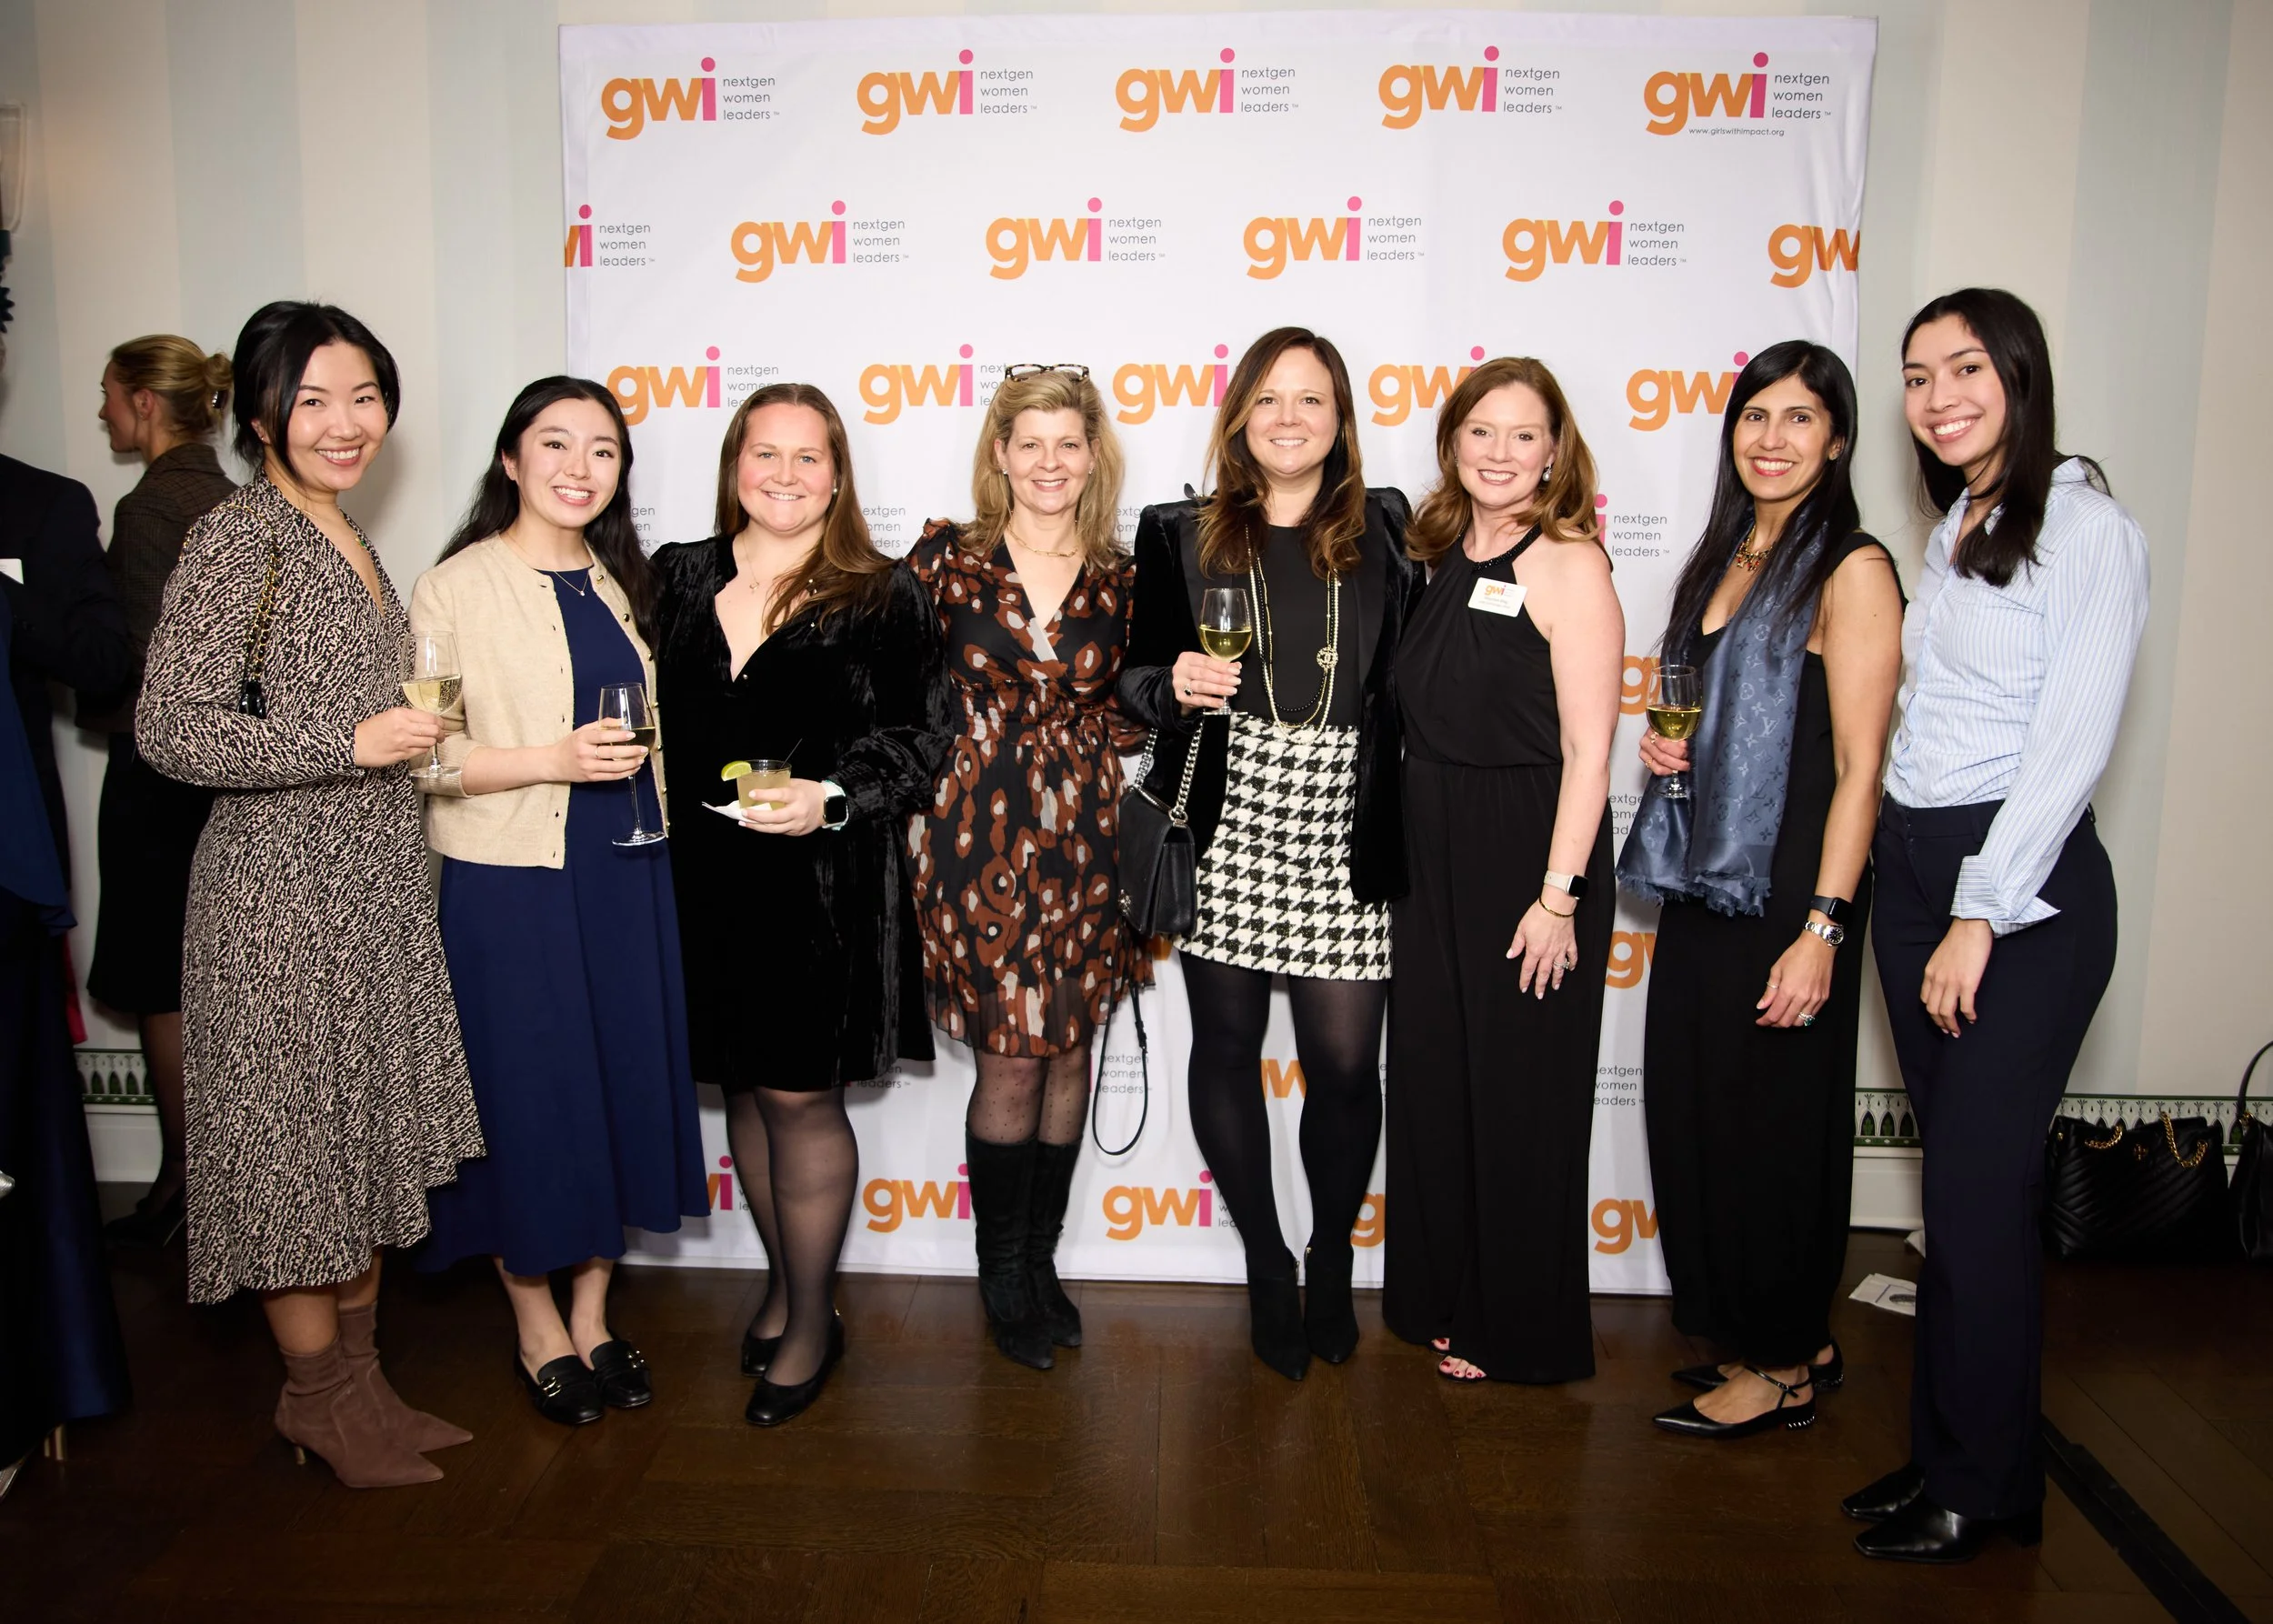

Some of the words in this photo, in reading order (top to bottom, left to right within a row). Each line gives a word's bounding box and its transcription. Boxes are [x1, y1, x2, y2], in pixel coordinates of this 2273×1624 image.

[980, 68, 1034, 82] nextgen
[1242, 66, 1296, 80] nextgen
[1506, 67, 1560, 81] nextgen
[1774, 73, 1830, 86] nextgen
[723, 76, 776, 88] nextgen
[1378, 45, 1498, 129] gwi
[856, 49, 974, 135] gwi
[980, 86, 1028, 96] women
[1116, 48, 1235, 133] gwi
[1241, 85, 1290, 95] women
[1505, 85, 1554, 95] women
[1644, 52, 1768, 135] gwi
[1773, 90, 1823, 101] women
[601, 57, 716, 141] gwi
[723, 94, 770, 103] women
[854, 219, 906, 232] nextgen
[1109, 217, 1162, 230] nextgen
[1368, 215, 1422, 228] nextgen
[1630, 221, 1685, 235] nextgen
[599, 223, 651, 236] nextgen
[599, 240, 646, 249] women
[731, 200, 846, 283] gwi
[853, 236, 900, 246] women
[986, 197, 1102, 280] gwi
[1109, 235, 1157, 244] women
[1244, 196, 1362, 280] gwi
[1367, 234, 1416, 243] women
[1502, 200, 1624, 282] gwi
[1628, 238, 1678, 249] women
[1768, 224, 1859, 288] gw
[727, 365, 779, 377] nextgen
[606, 346, 720, 426] gwi
[859, 345, 973, 425] gwi
[1113, 344, 1228, 425] gwi
[863, 505, 906, 518] extgen
[1614, 513, 1667, 526] nextgen
[866, 522, 901, 532] omen
[1612, 531, 1661, 541] women
[1597, 1065, 1643, 1078] extgen
[1593, 1095, 1637, 1107] eaders
[863, 1163, 971, 1233] gwi
[1103, 1170, 1213, 1241] gwi
